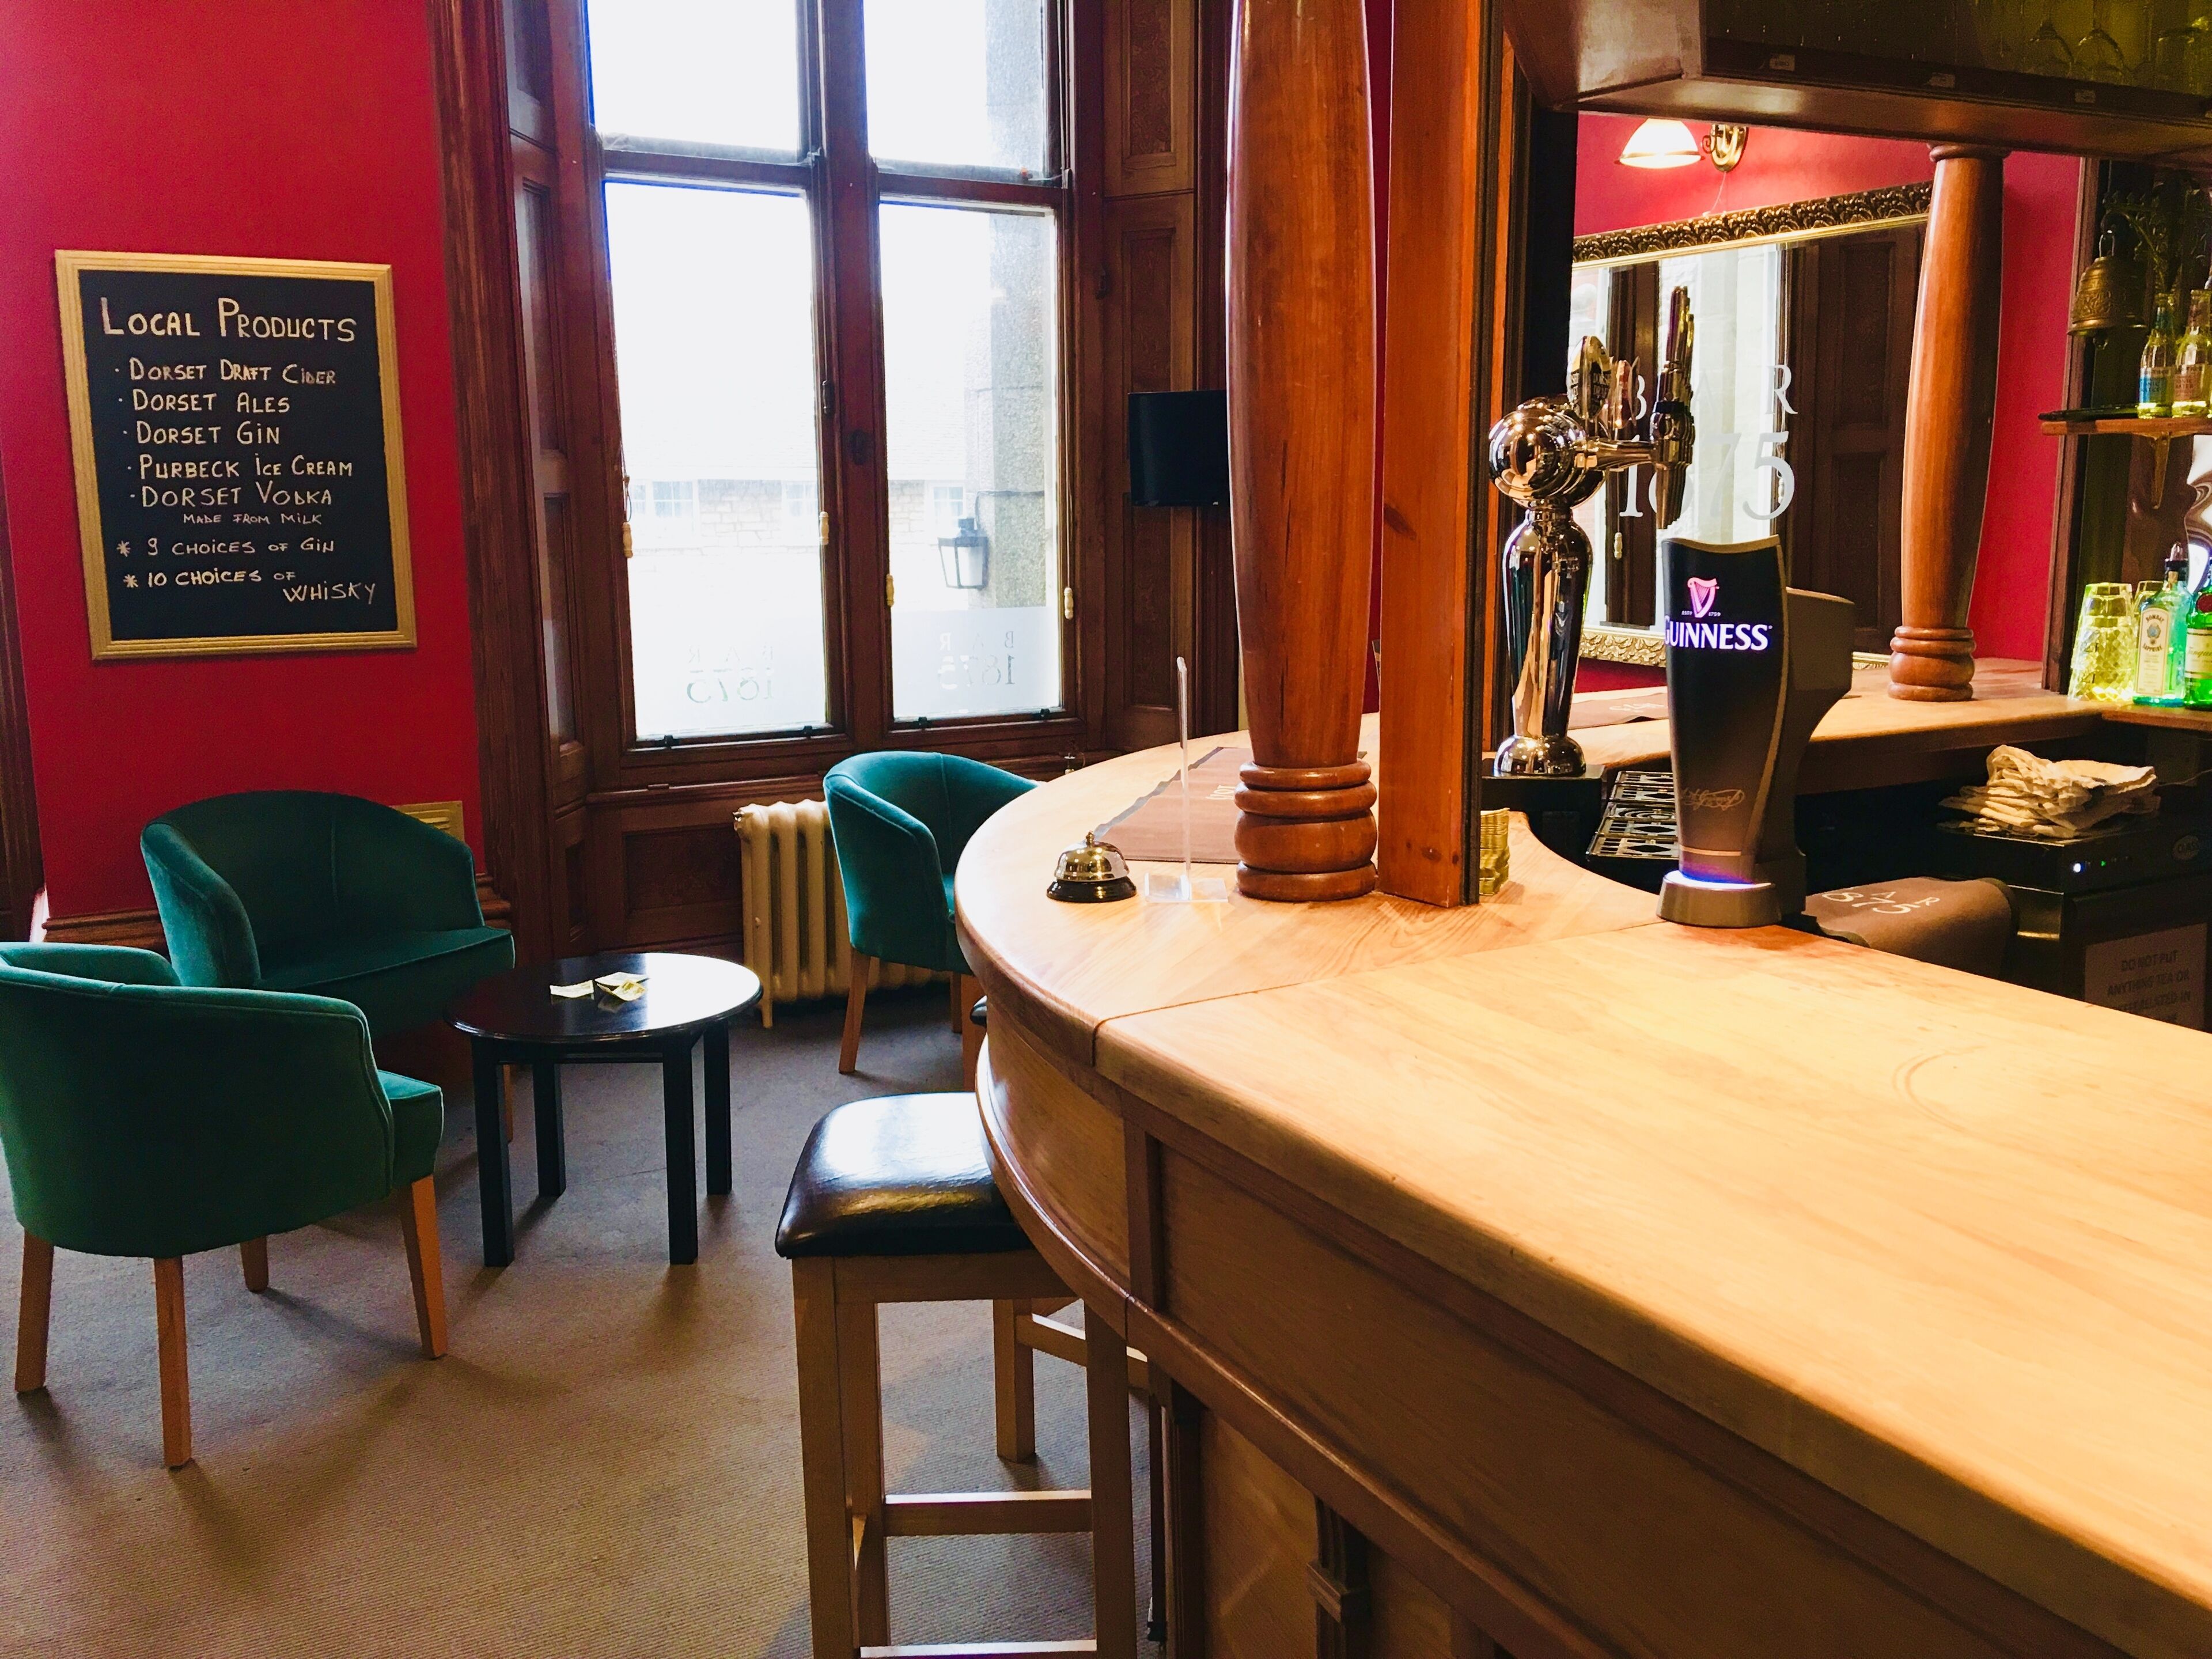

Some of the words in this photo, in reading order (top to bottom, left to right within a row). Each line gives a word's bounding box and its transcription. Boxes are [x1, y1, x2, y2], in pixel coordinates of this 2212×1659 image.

[100, 297, 200, 336] LOCAL
[218, 298, 357, 342] PRODUCTS
[129, 357, 207, 381] DORSET
[220, 358, 272, 381] DRAFT
[282, 363, 336, 385] CIDER
[132, 389, 218, 411] DORSET
[237, 392, 290, 414] ALES
[137, 421, 222, 445] DORSET
[237, 421, 280, 445] GIN
[140, 454, 240, 479] PURBECK
[255, 453, 282, 476] ICE
[291, 455, 353, 478] CREAM
[142, 485, 242, 507] DORSET
[255, 480, 332, 506] VODKA
[183, 513, 222, 525] MADE
[233, 513, 271, 525] FROM
[281, 513, 323, 525] MILK
[172, 539, 256, 555] CHOICES
[268, 541, 289, 552] OF
[300, 538, 335, 552] GIN
[147, 572, 168, 587] 10
[175, 567, 263, 586] CHOICES
[274, 571, 297, 582] OF
[283, 581, 376, 604] WHISKY
